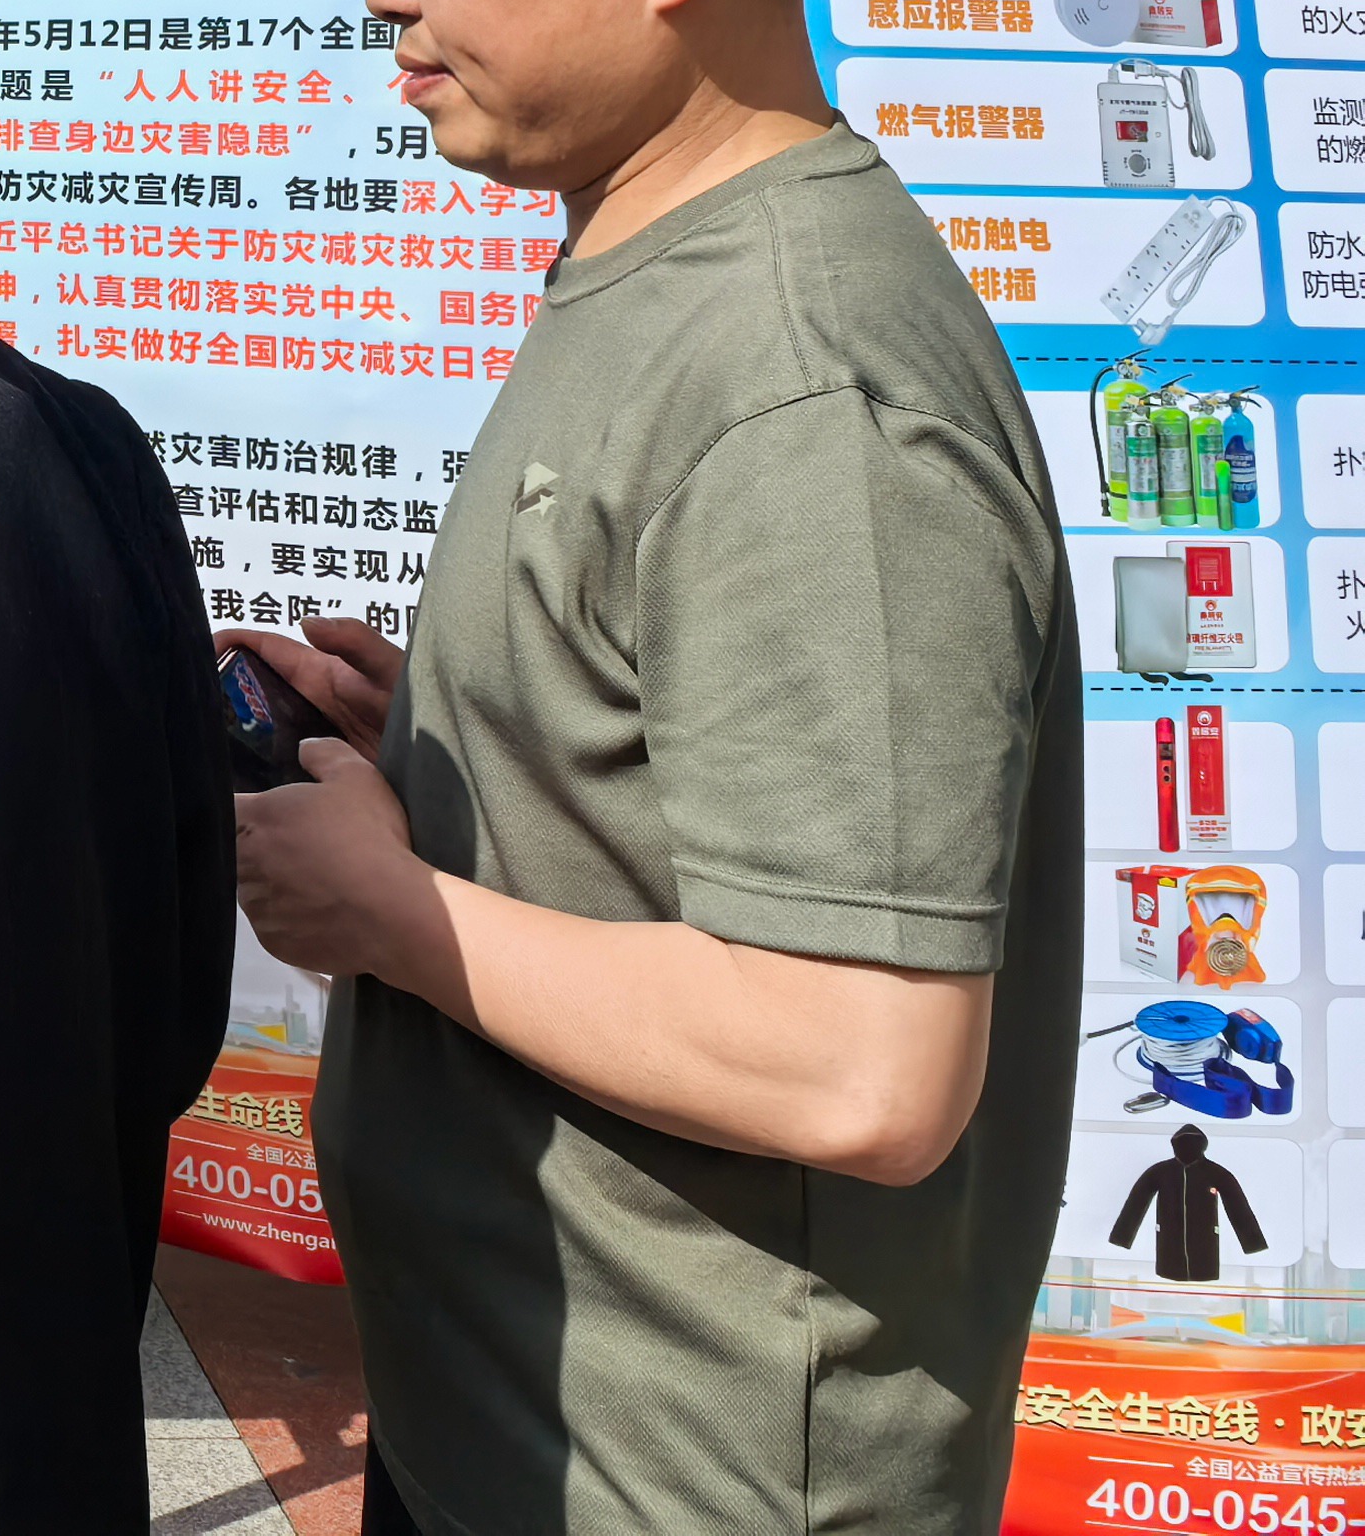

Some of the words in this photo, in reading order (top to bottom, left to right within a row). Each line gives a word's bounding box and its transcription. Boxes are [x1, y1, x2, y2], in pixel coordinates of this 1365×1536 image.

[875, 103, 1045, 140] 燃气报警器
[1307, 231, 1365, 260] 防水
[969, 267, 1036, 301] 排插
[1333, 446, 1365, 478] 扑
[173, 484, 449, 534] 查评估和动态监
[181, 1086, 304, 1138] 生命线
[246, 1143, 317, 1170] 全国公益
[172, 1155, 324, 1213] 400-05
[1014, 1383, 1365, 1447] 安全生命线·政
[1186, 1456, 1365, 1486] 全国公益宣传热线
